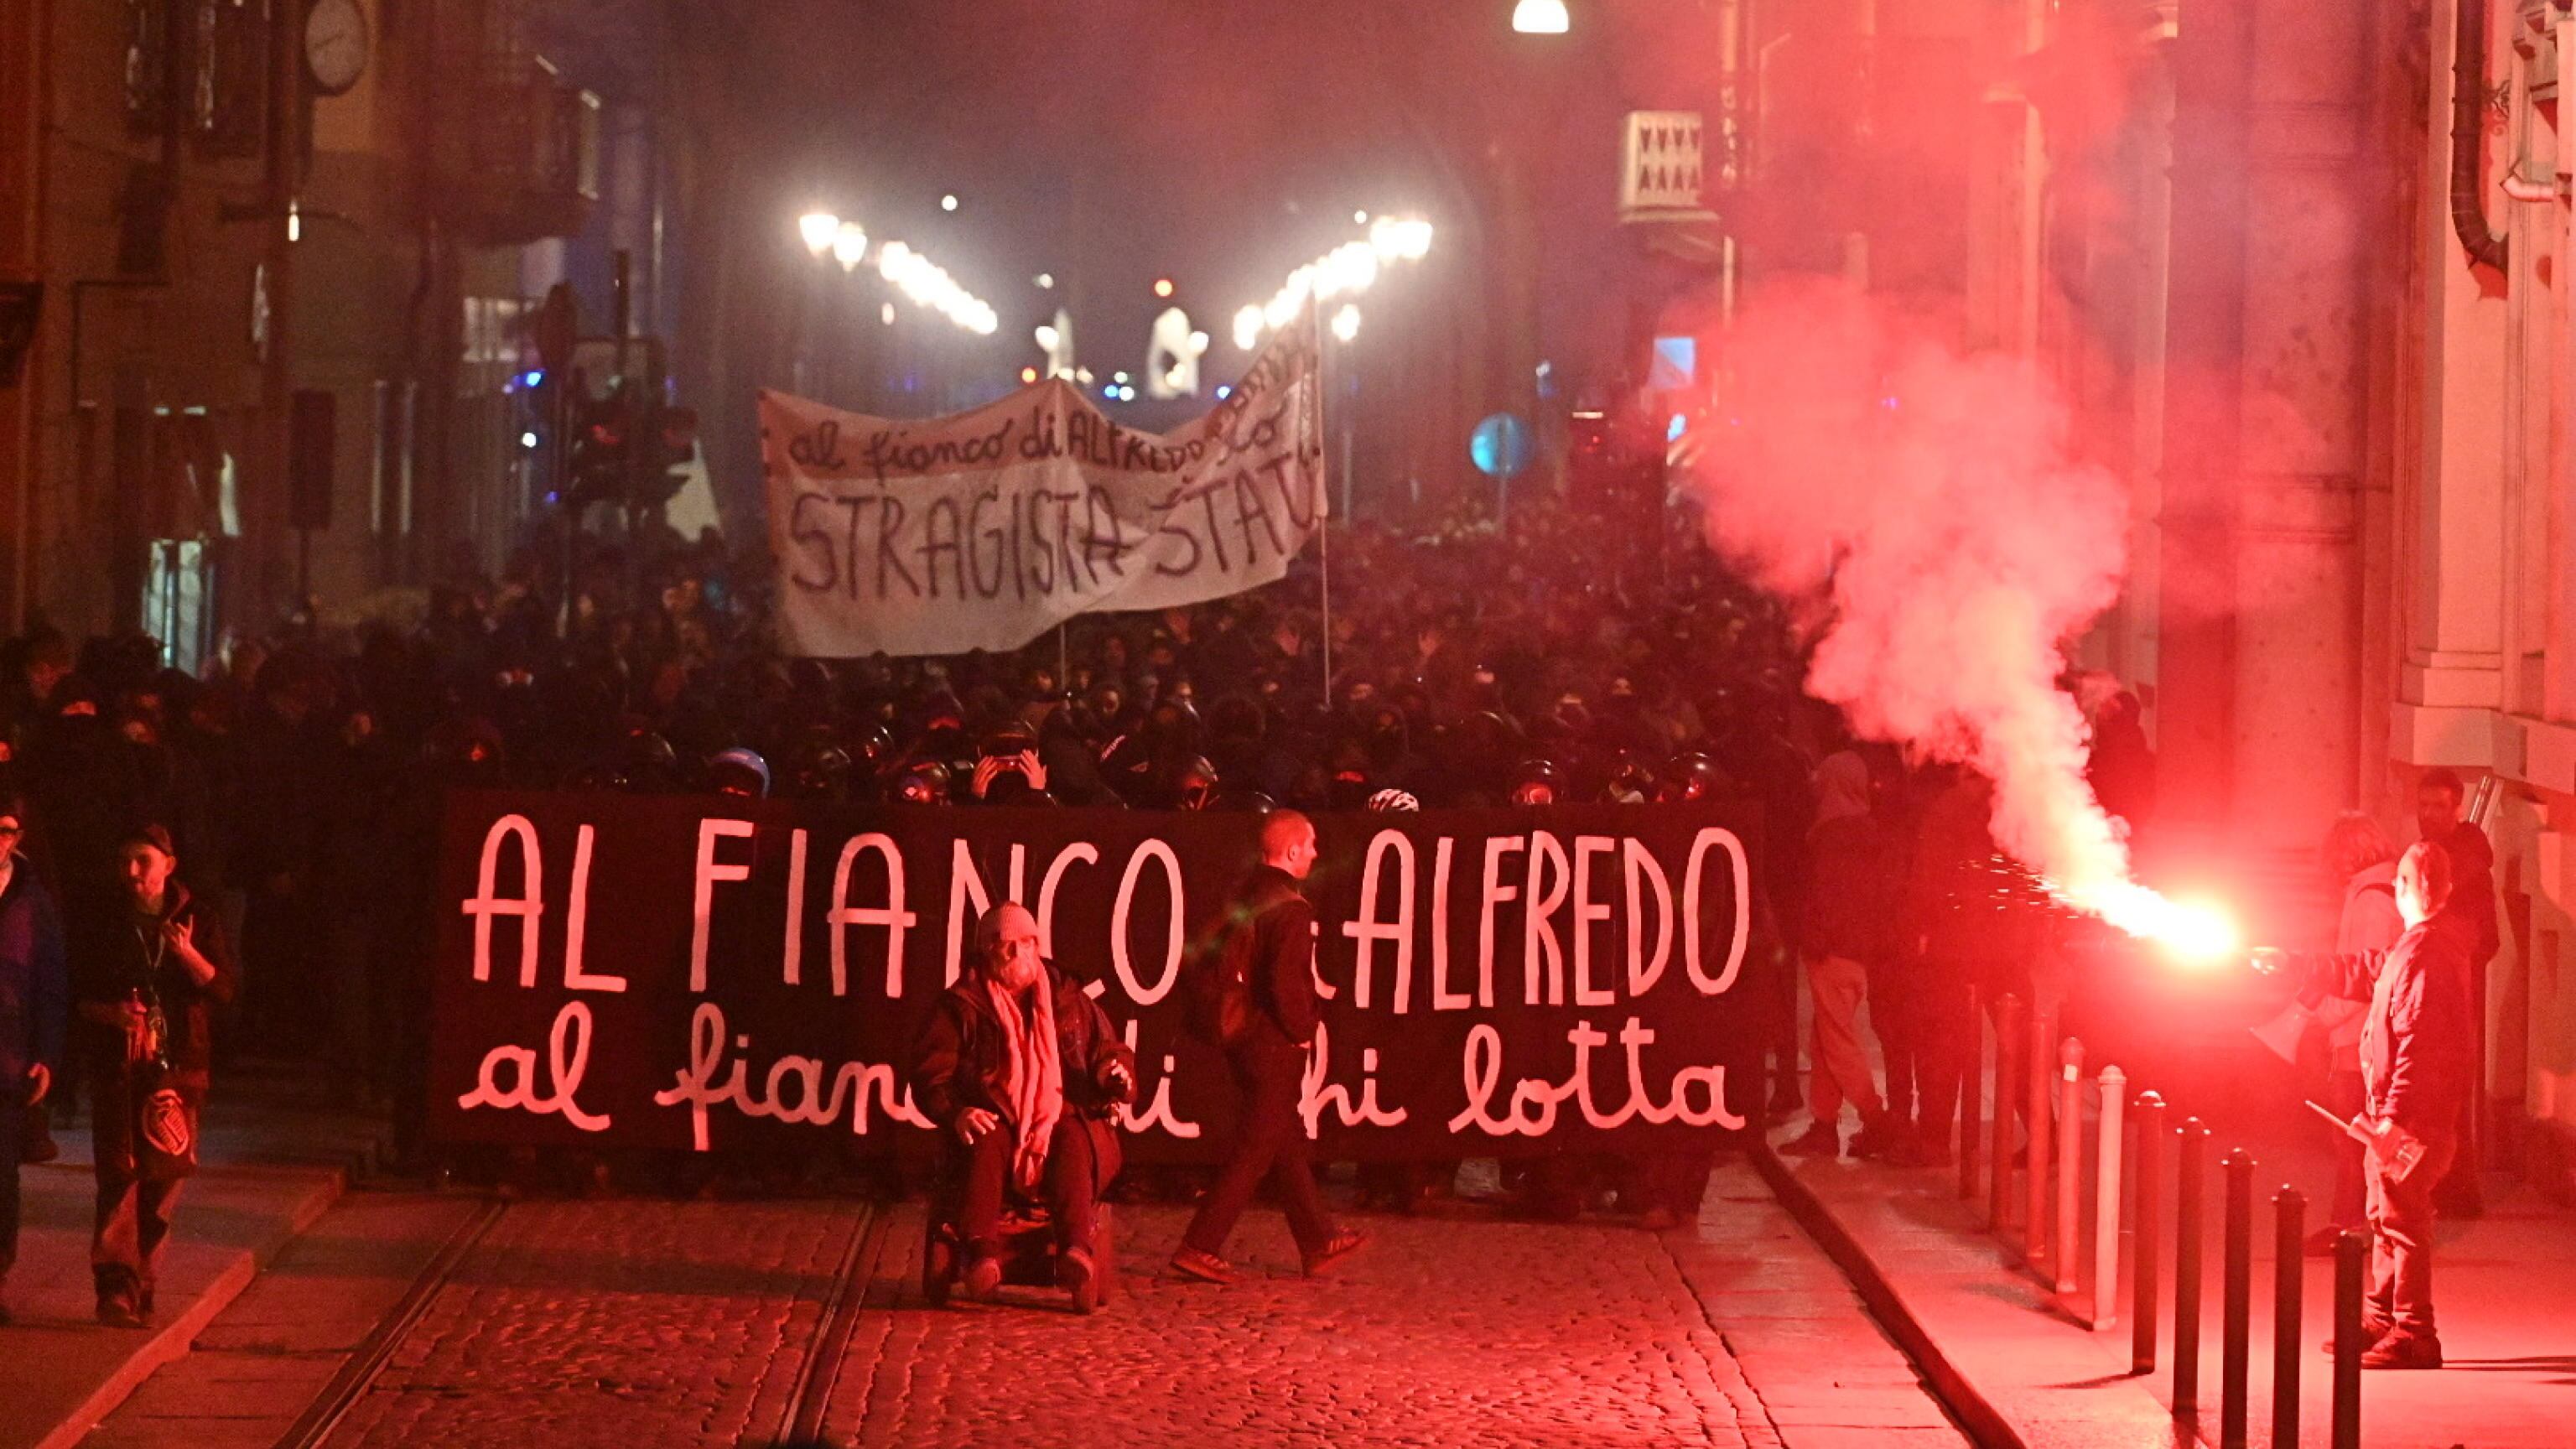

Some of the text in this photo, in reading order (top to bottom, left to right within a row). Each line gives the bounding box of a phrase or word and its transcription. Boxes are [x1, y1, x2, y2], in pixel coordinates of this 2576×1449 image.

[788, 420, 847, 470] al
[862, 418, 1015, 488] fianco
[1017, 405, 1063, 460] di
[790, 483, 1134, 603] STRAGISTA
[461, 813, 628, 995] AL
[689, 818, 1185, 1007] FIANCO
[1342, 826, 1751, 1015] ALFREDO
[458, 1000, 611, 1132] al
[653, 1002, 938, 1152] fian
[1296, 1020, 1409, 1140] hi
[1447, 1015, 1747, 1138] lotta
